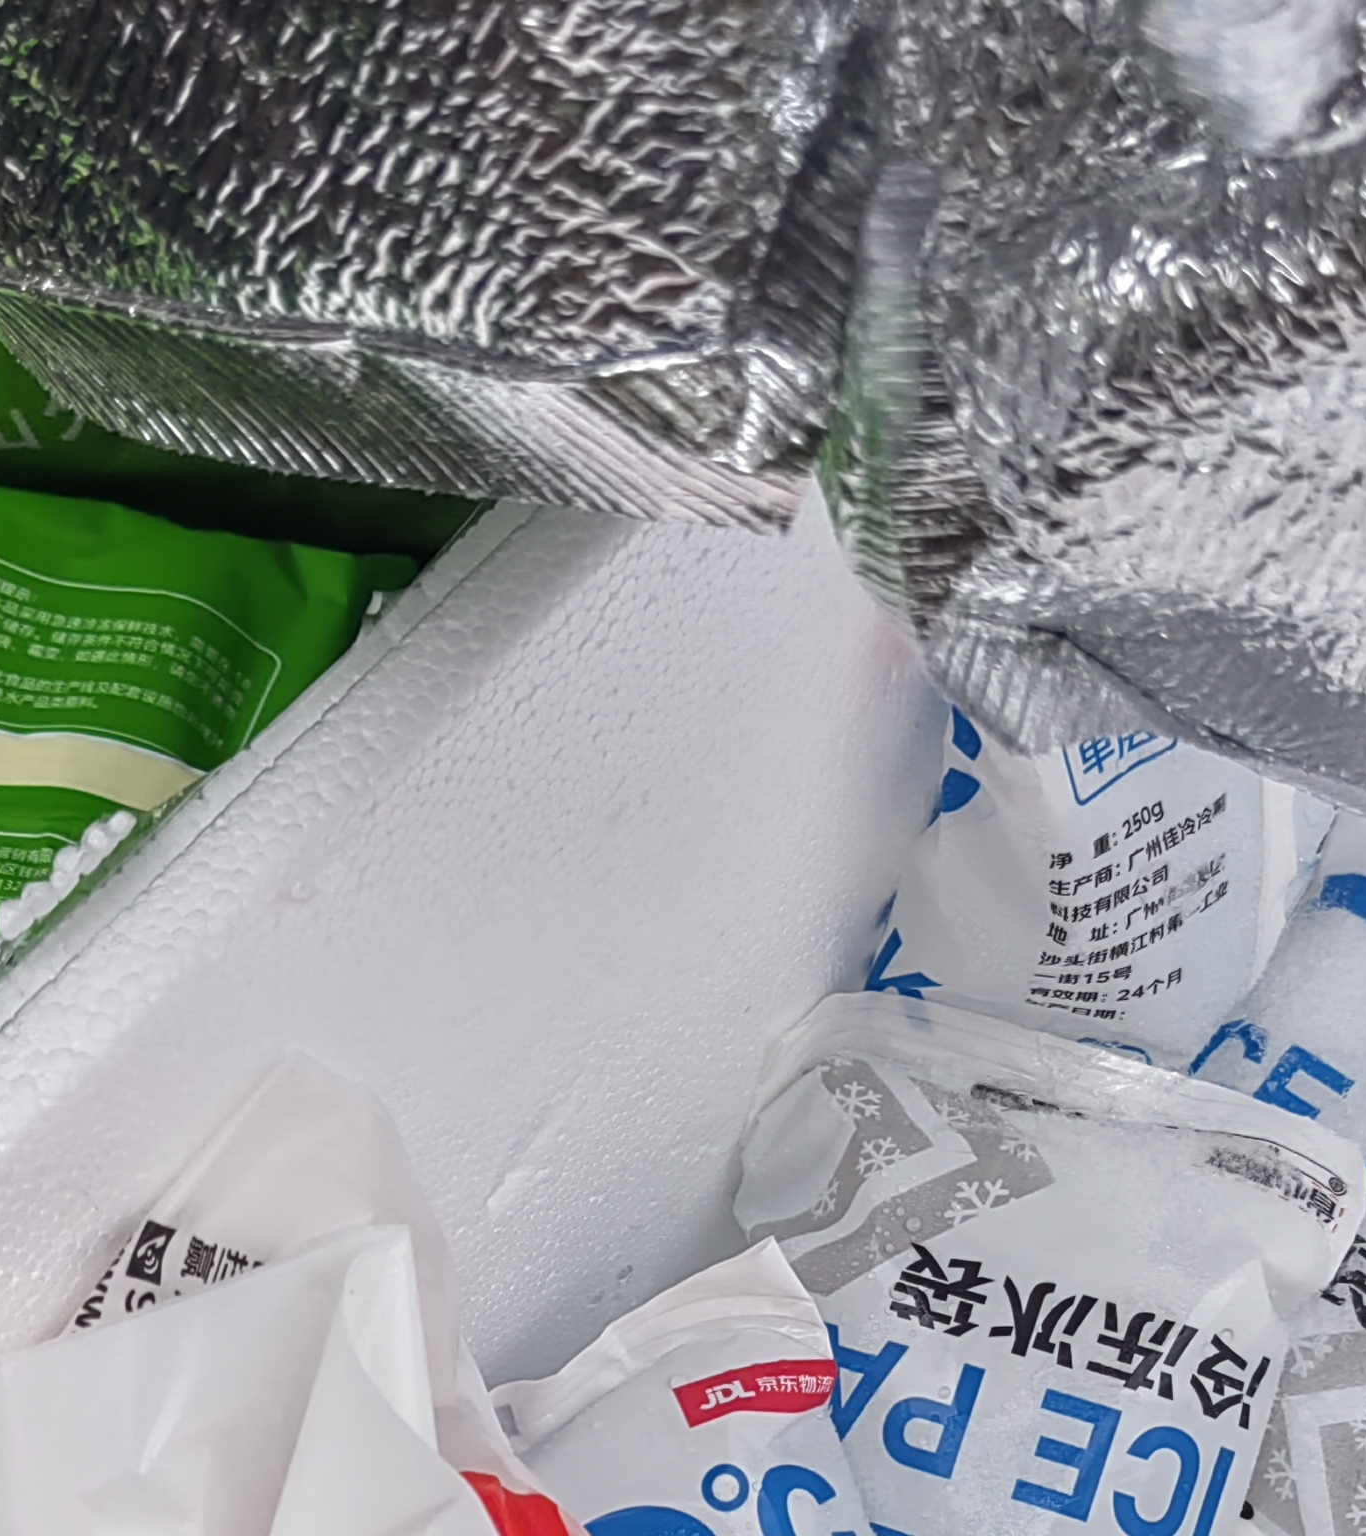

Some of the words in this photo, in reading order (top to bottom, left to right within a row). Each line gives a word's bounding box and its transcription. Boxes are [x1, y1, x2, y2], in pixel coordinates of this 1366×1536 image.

[1050, 864, 1168, 922] 科技有限公司
[888, 1240, 1271, 1430] 冷冻冰袋
[756, 1374, 834, 1395] 京东物流
